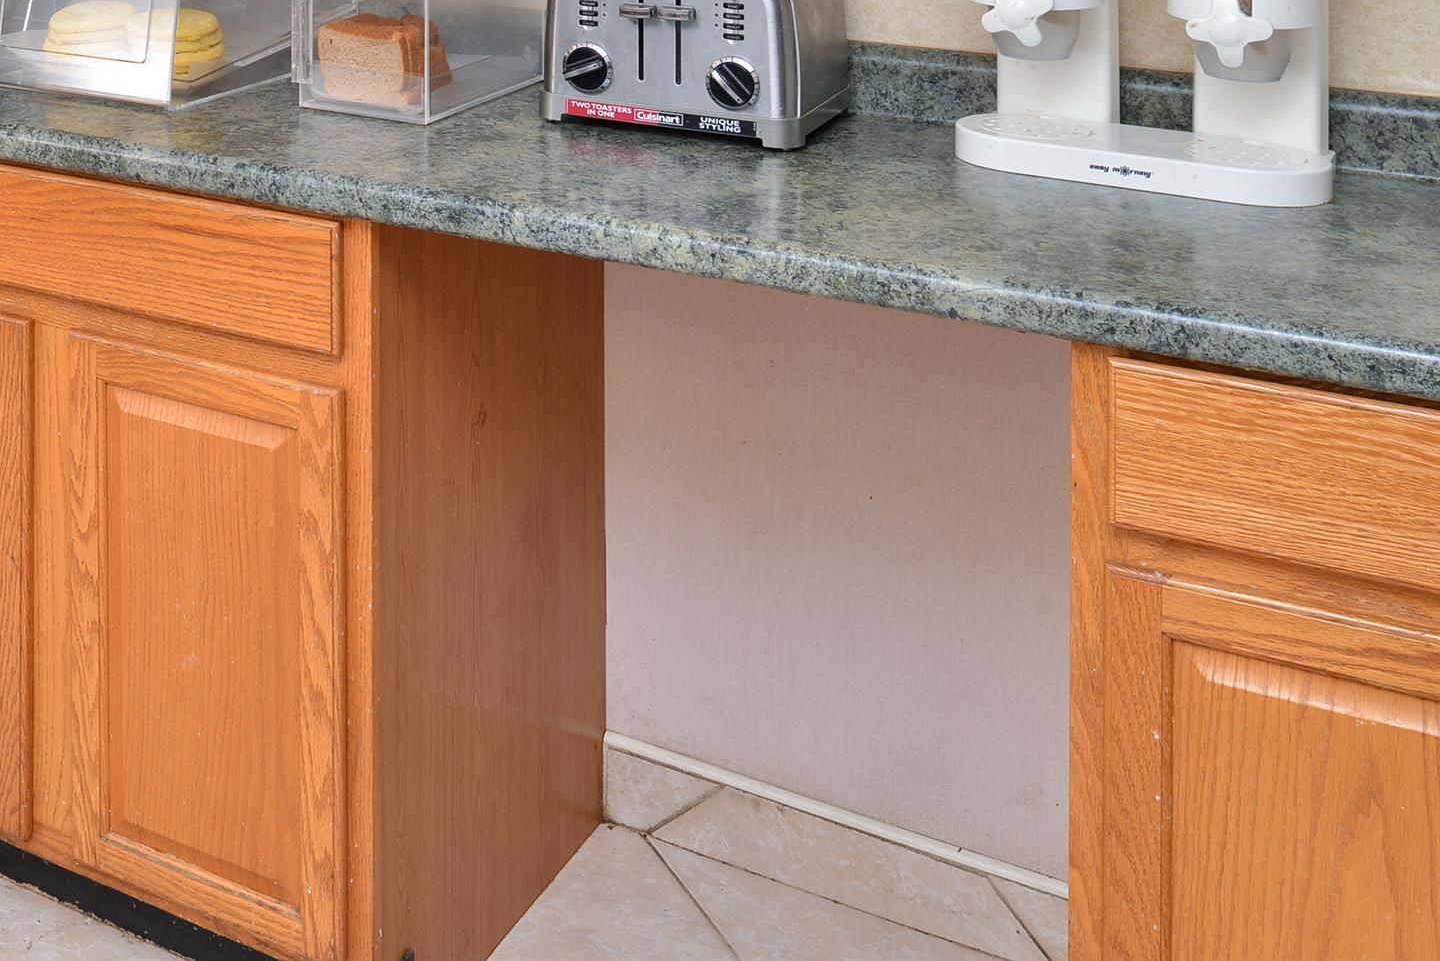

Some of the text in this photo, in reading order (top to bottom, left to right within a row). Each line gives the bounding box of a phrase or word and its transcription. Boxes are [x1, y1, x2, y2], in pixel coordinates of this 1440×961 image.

[571, 100, 632, 114] TWO TOASTERS
[598, 110, 615, 118] ONE
[636, 111, 680, 124] Cuisinart
[700, 116, 740, 127] UNIQUE
[699, 123, 741, 133] STYLING
[1089, 164, 1109, 172] easy
